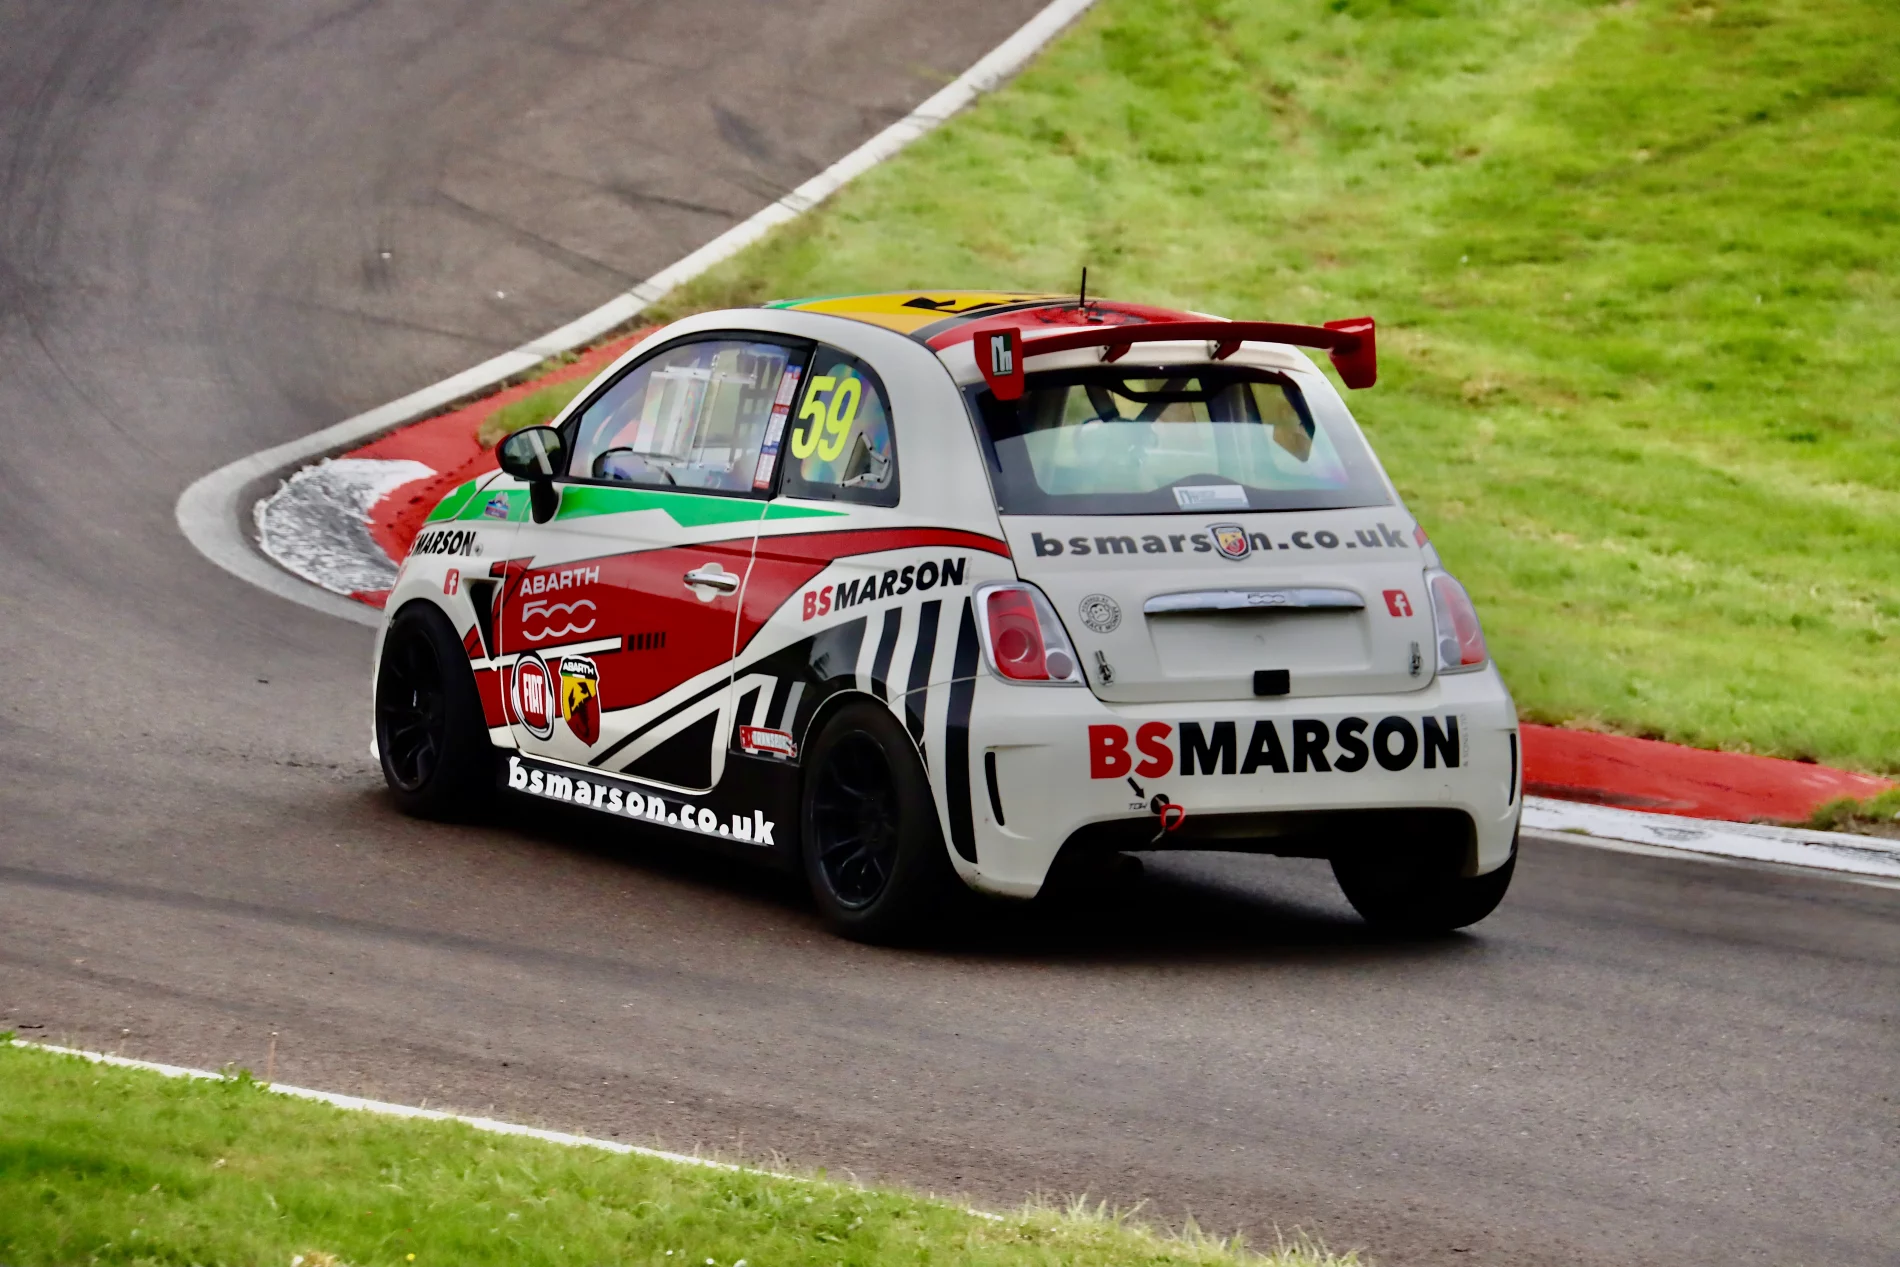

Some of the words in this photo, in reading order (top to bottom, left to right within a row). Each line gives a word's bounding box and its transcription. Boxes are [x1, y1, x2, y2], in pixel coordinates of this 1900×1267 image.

[792, 376, 861, 462] 59
[1031, 523, 1409, 558] bsmarsn.co.uk
[519, 565, 600, 597] ABARTH
[522, 599, 596, 641] 500
[563, 661, 594, 675] ABARTH
[523, 672, 543, 715] FIAT
[508, 756, 775, 845] bsmarson.co.uk
